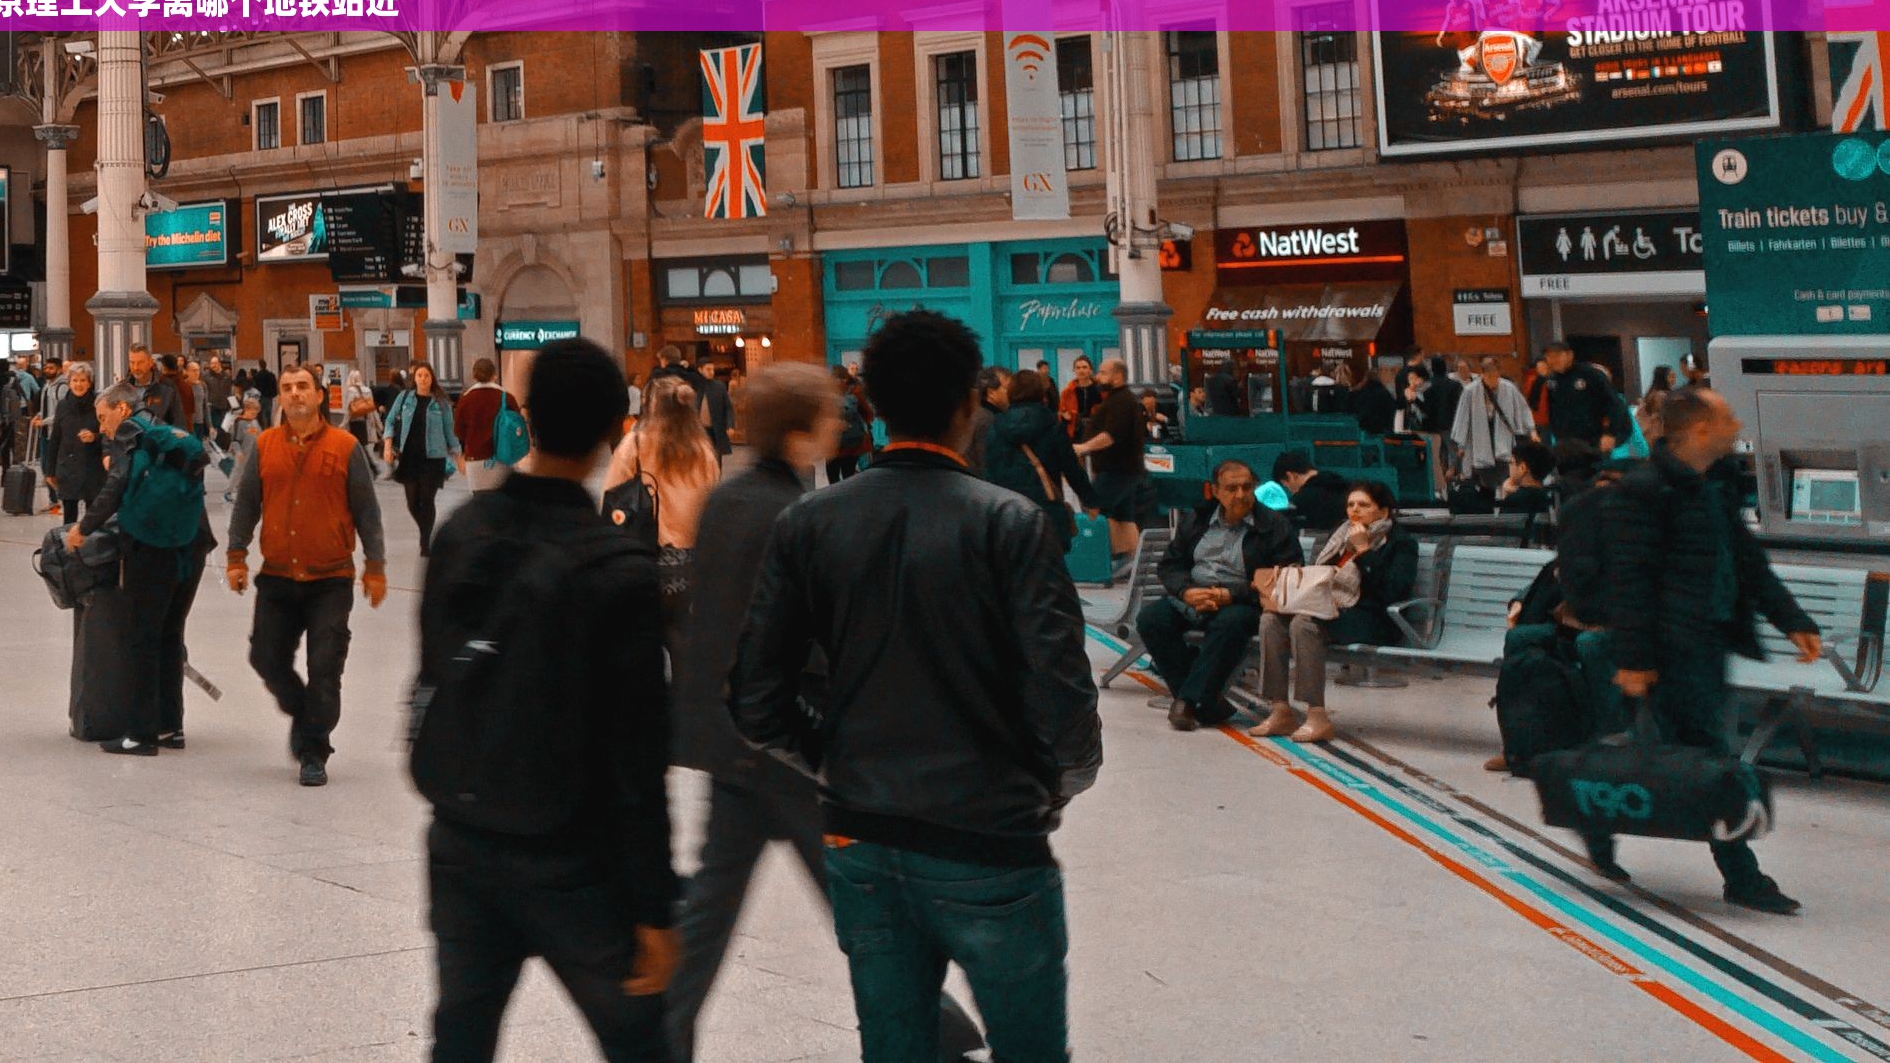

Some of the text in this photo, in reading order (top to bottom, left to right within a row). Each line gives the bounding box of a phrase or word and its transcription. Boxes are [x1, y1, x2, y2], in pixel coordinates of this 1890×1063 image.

[1566, 0, 1747, 47] STADIUM TOUR
[1569, 30, 1747, 59] GET CLOSER TO THE HOME OF FOOTBALL
[1612, 81, 1708, 99] arsenal.com/tours
[1023, 172, 1054, 192] GX
[267, 213, 286, 234] ALEX
[287, 202, 313, 225] CROSS
[448, 218, 470, 233] GX
[1718, 208, 1761, 229] Train
[1766, 206, 1829, 227] tickets
[1835, 204, 1867, 228] buy
[145, 230, 221, 248] Try the Michelin diet
[1259, 227, 1359, 257] NatWest
[1540, 278, 1569, 290] FREE
[710, 310, 741, 324] CASA
[1019, 298, 1101, 331] Paperchase
[1206, 303, 1385, 321] Free cash withdrawals
[1468, 314, 1497, 326] FREE
[504, 329, 577, 341] CURRENCY EXCHANGE
[1321, 348, 1353, 358] NatWest
